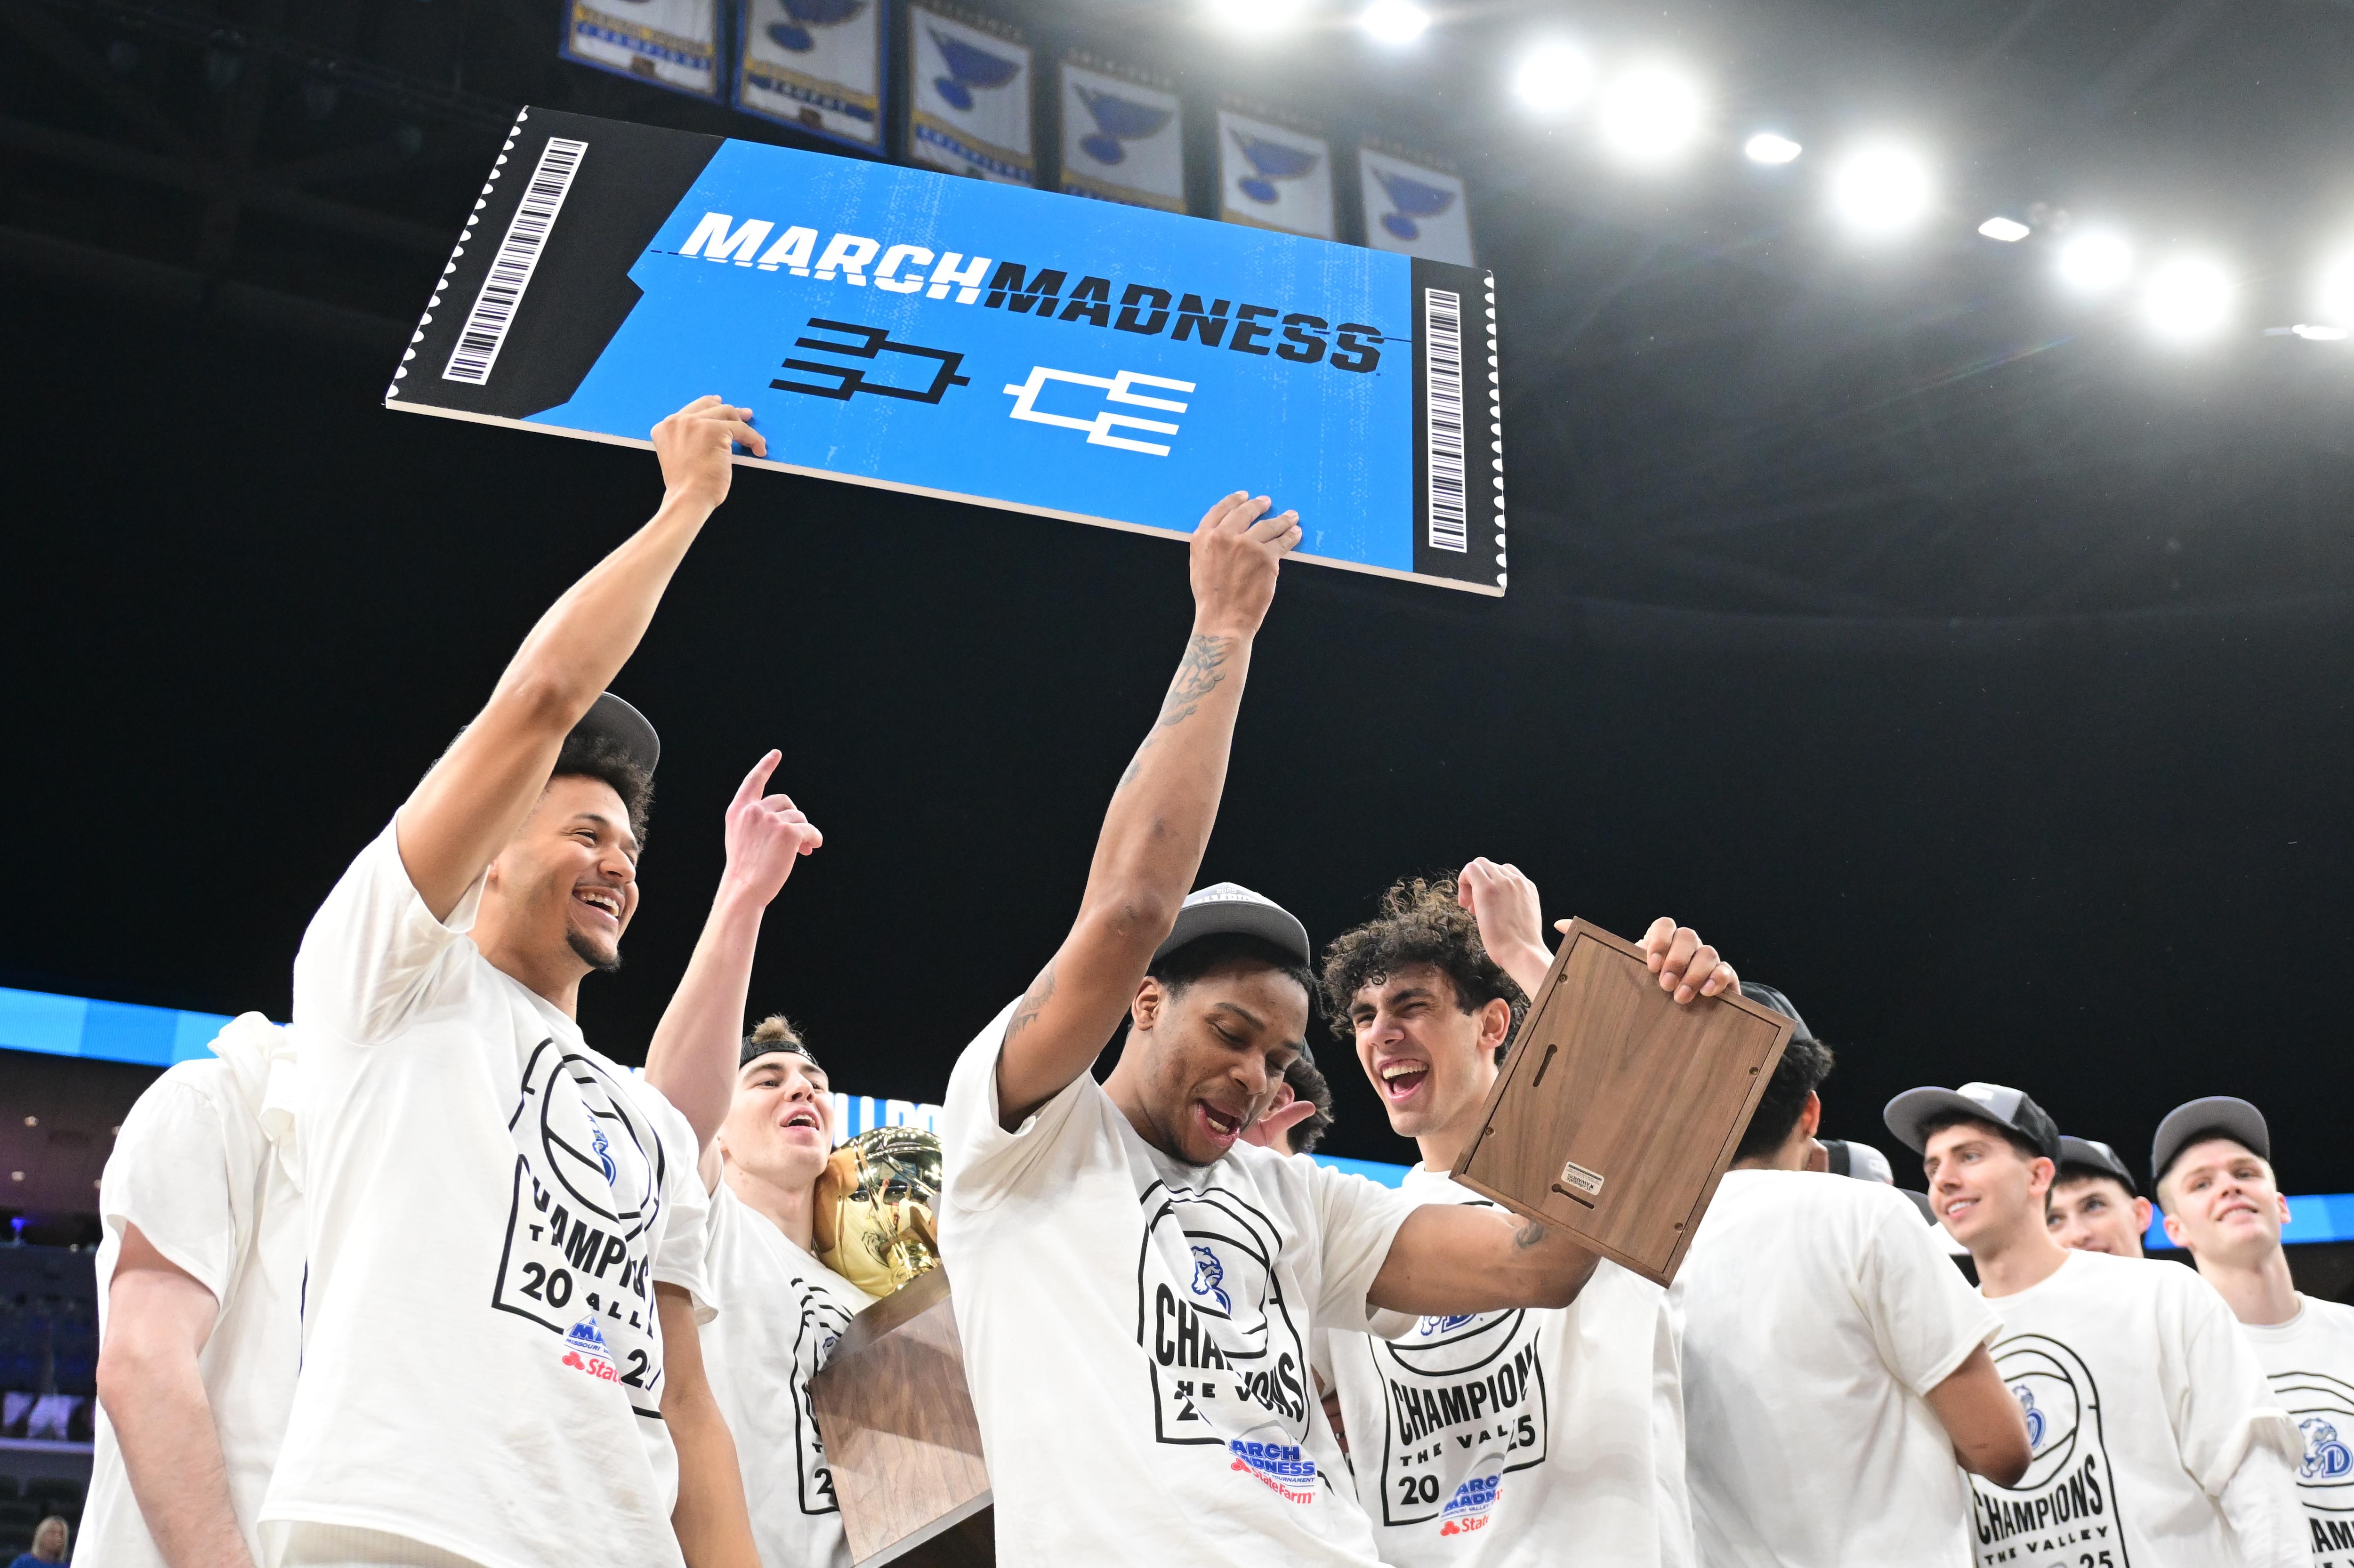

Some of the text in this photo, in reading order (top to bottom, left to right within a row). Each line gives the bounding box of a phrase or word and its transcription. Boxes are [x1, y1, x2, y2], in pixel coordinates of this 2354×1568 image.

[678, 212, 1385, 374] MARCH MADNESS
[519, 1262, 573, 1308] 20
[565, 1338, 601, 1351] MISSOURI
[1177, 1380, 1215, 1398] HE
[1390, 1342, 1532, 1446] CHAMPION
[1230, 1439, 1301, 1461] ARCH
[1400, 1424, 1508, 1466] THE VAL
[1272, 1475, 1315, 1483] TOURNAMENT
[1398, 1474, 1439, 1505] 20
[1985, 1526, 2108, 1566] THE VALLEY
